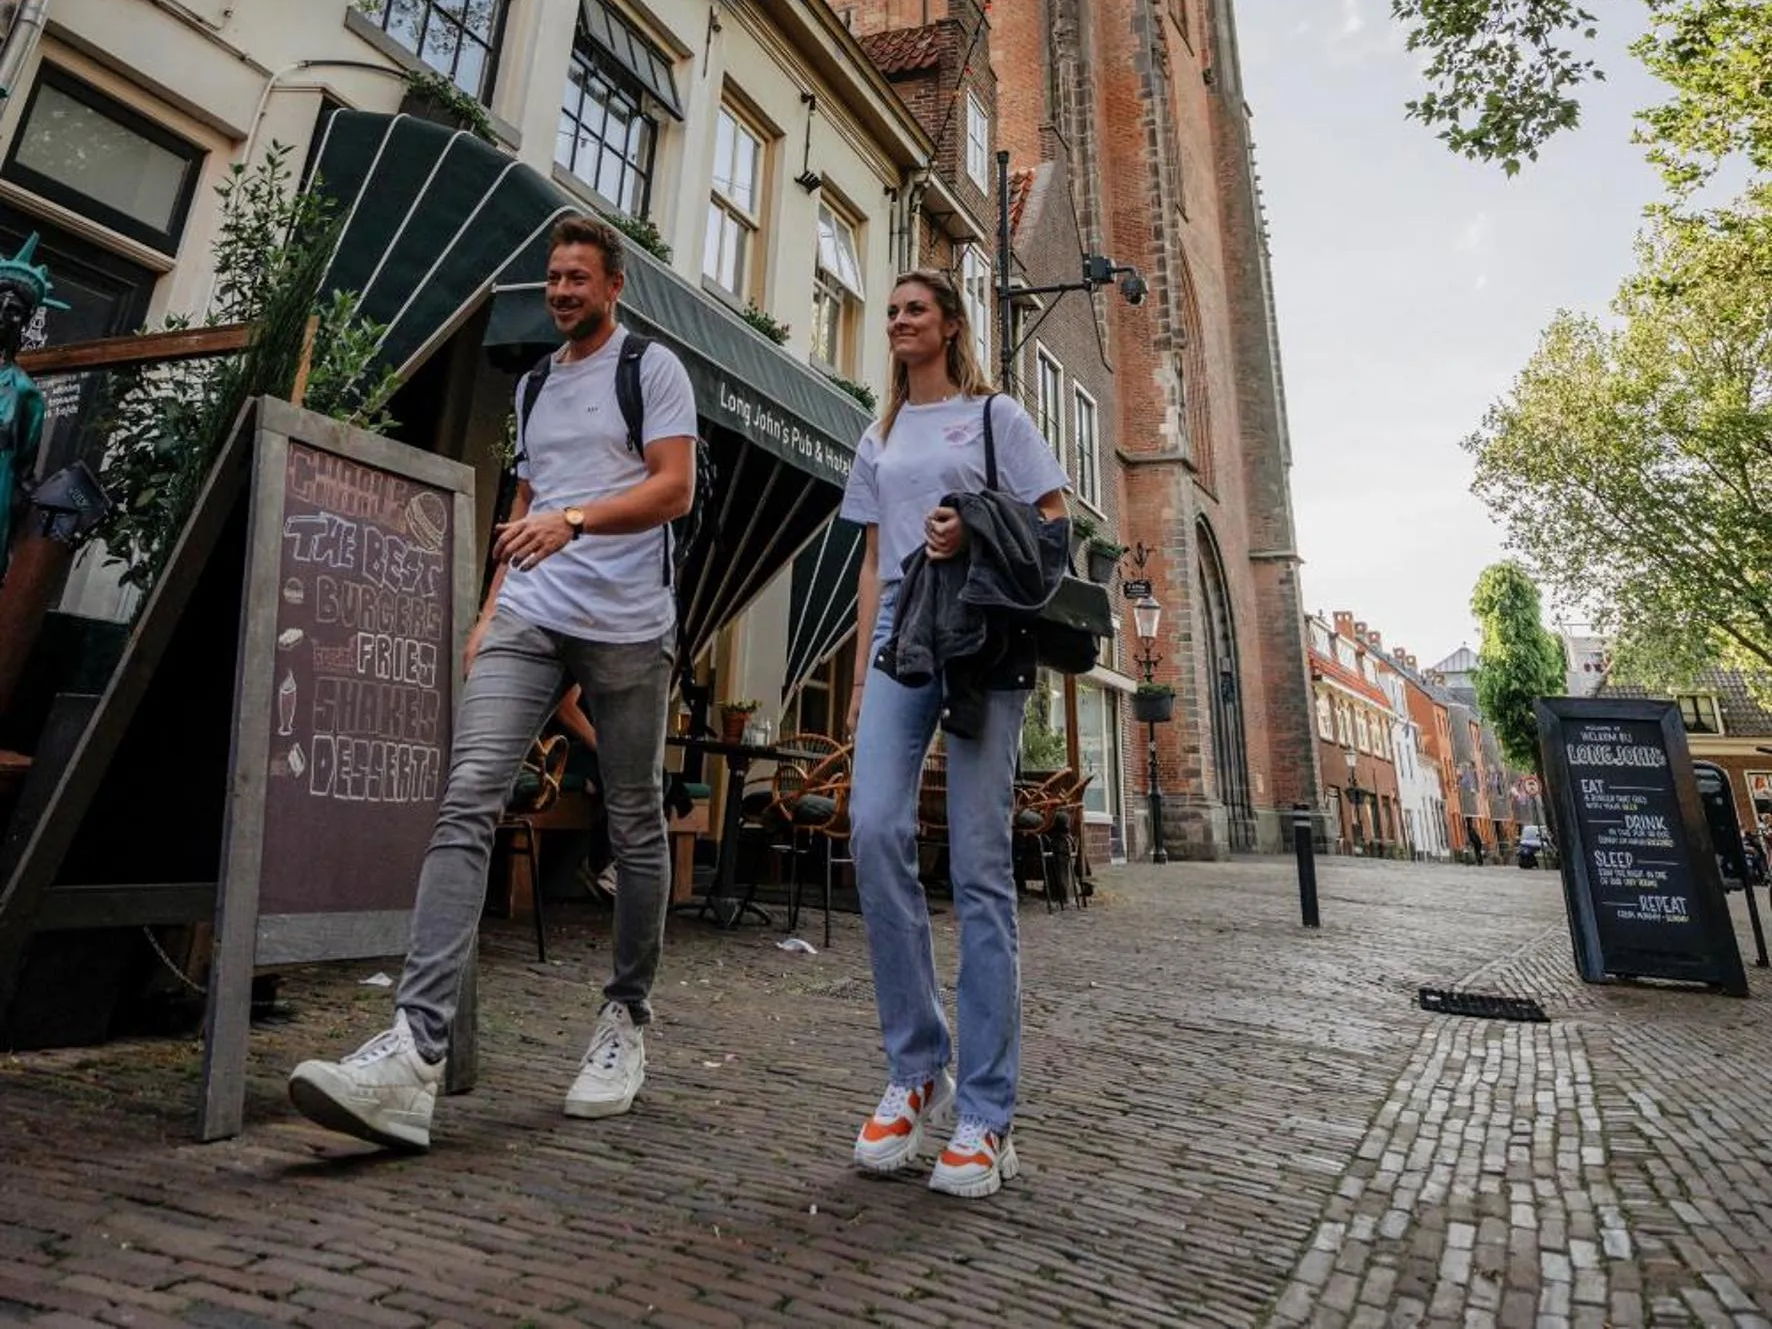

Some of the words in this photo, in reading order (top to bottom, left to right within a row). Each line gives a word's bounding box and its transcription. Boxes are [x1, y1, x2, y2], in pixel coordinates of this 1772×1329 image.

[720, 382, 750, 427] Long
[753, 404, 790, 444] John's
[791, 426, 813, 456] Pub
[814, 439, 823, 463] &
[284, 511, 357, 568] THE
[362, 525, 444, 598] BEST
[316, 575, 443, 640] BURGERS
[357, 632, 437, 688] FRIES
[312, 676, 440, 745] SHAKES
[310, 734, 440, 803] DESSERTS
[1581, 778, 1604, 793] EAT
[1624, 815, 1667, 831] DRINK
[1594, 850, 1633, 869] SLEEP
[1639, 894, 1687, 915] REPEAT
